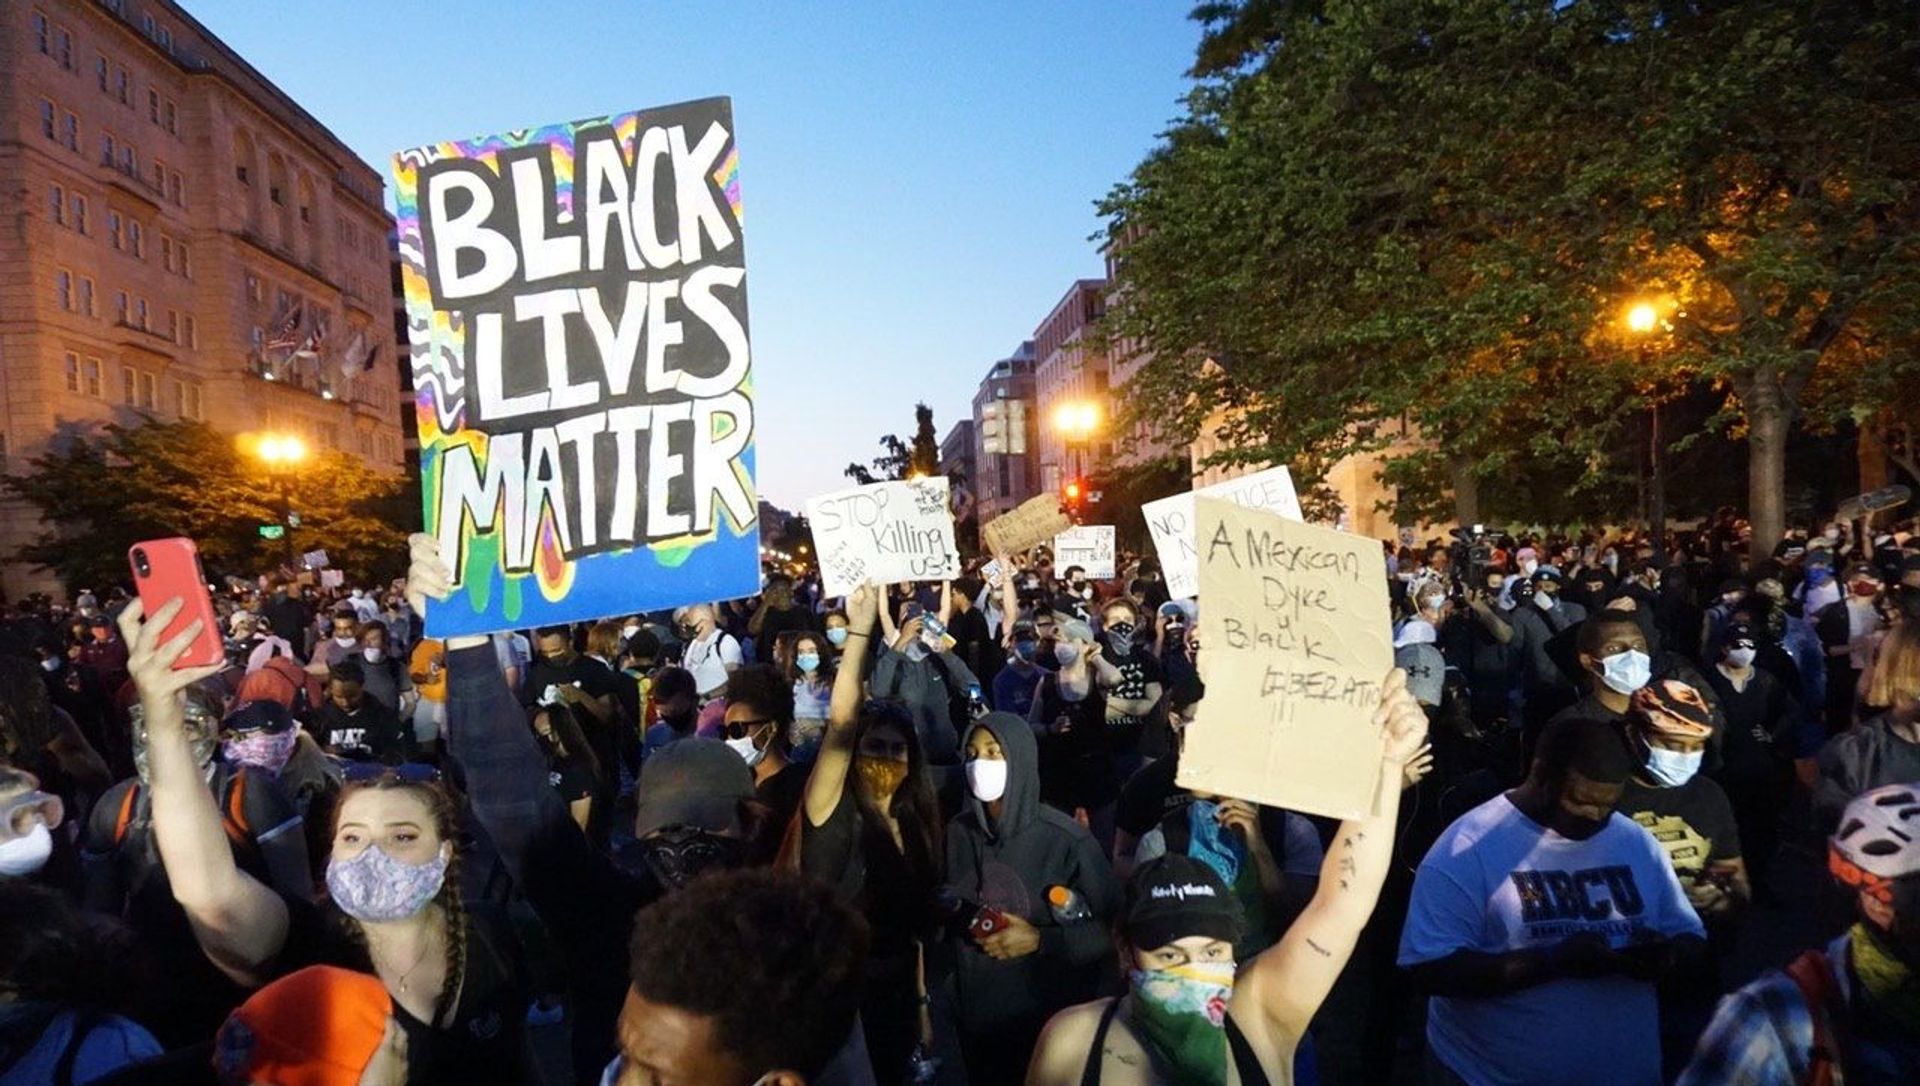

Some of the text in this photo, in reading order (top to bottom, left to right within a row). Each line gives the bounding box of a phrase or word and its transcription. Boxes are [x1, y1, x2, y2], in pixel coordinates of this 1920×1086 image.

[429, 120, 734, 298] BLACK
[475, 264, 750, 421] LIVES
[437, 390, 757, 585] MATTER
[818, 488, 889, 532] STOP
[871, 520, 945, 555] Killing
[1152, 511, 1186, 540] NO
[1179, 538, 1199, 560] N
[1207, 519, 1359, 582] A Mexican
[1262, 575, 1338, 622] Dyke
[1224, 617, 1343, 666] Black
[1260, 664, 1382, 707] LIBERATIO
[1509, 864, 1645, 923] HBCU
